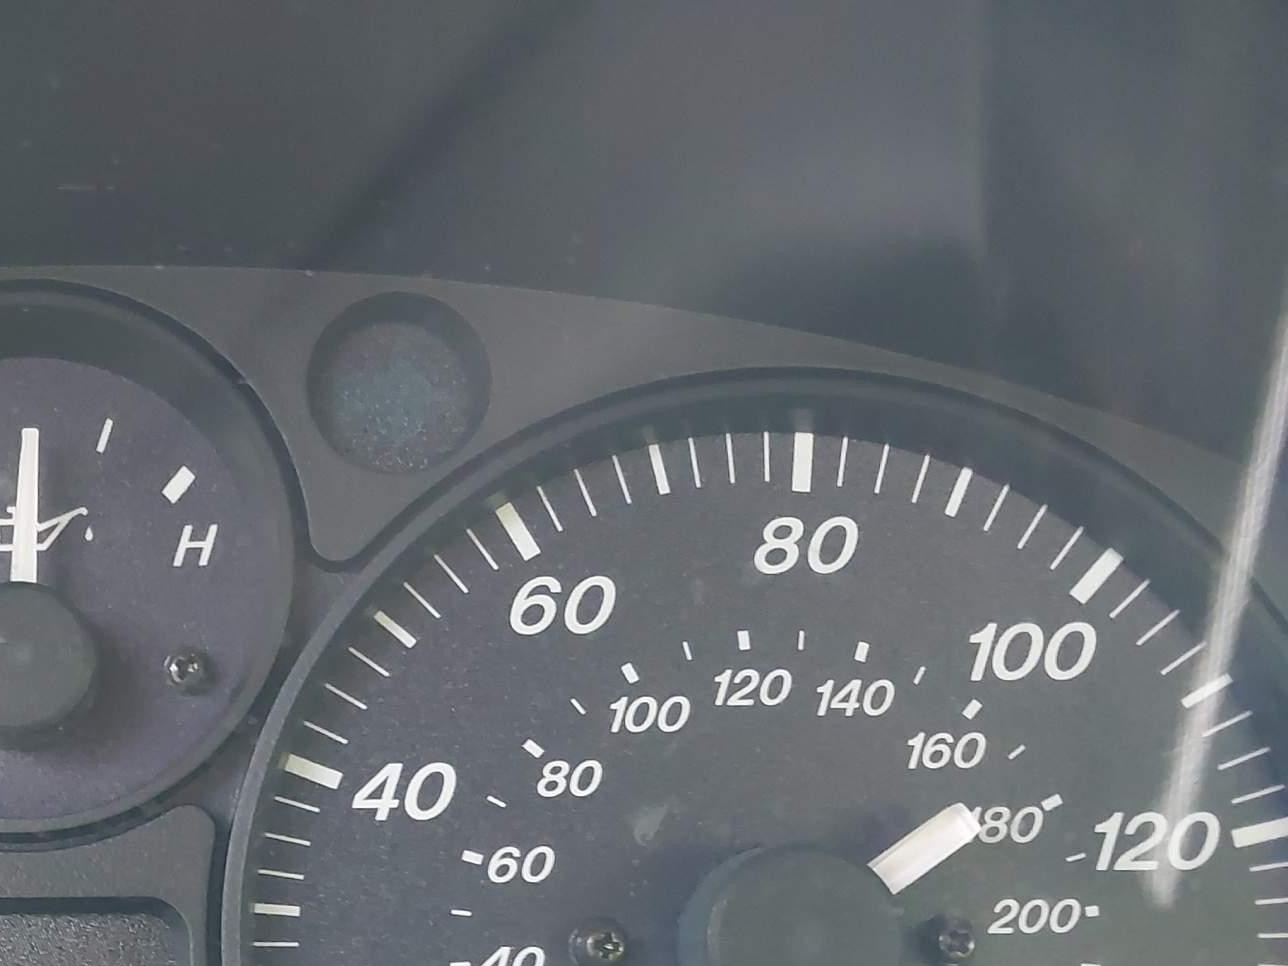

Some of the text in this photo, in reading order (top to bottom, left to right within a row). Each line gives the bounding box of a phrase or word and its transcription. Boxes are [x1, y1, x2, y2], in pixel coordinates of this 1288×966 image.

[172, 525, 218, 567] H
[753, 516, 859, 574] 80
[509, 575, 617, 636] 60
[969, 622, 1097, 682] 100
[713, 669, 792, 707] 120
[816, 678, 895, 717] 140
[609, 696, 691, 733] 100
[907, 732, 987, 769] 160
[352, 762, 457, 821] 40
[536, 760, 603, 797] 80
[1094, 811, 1220, 871] 120
[487, 845, 555, 883] 60
[987, 898, 1081, 934] 200
